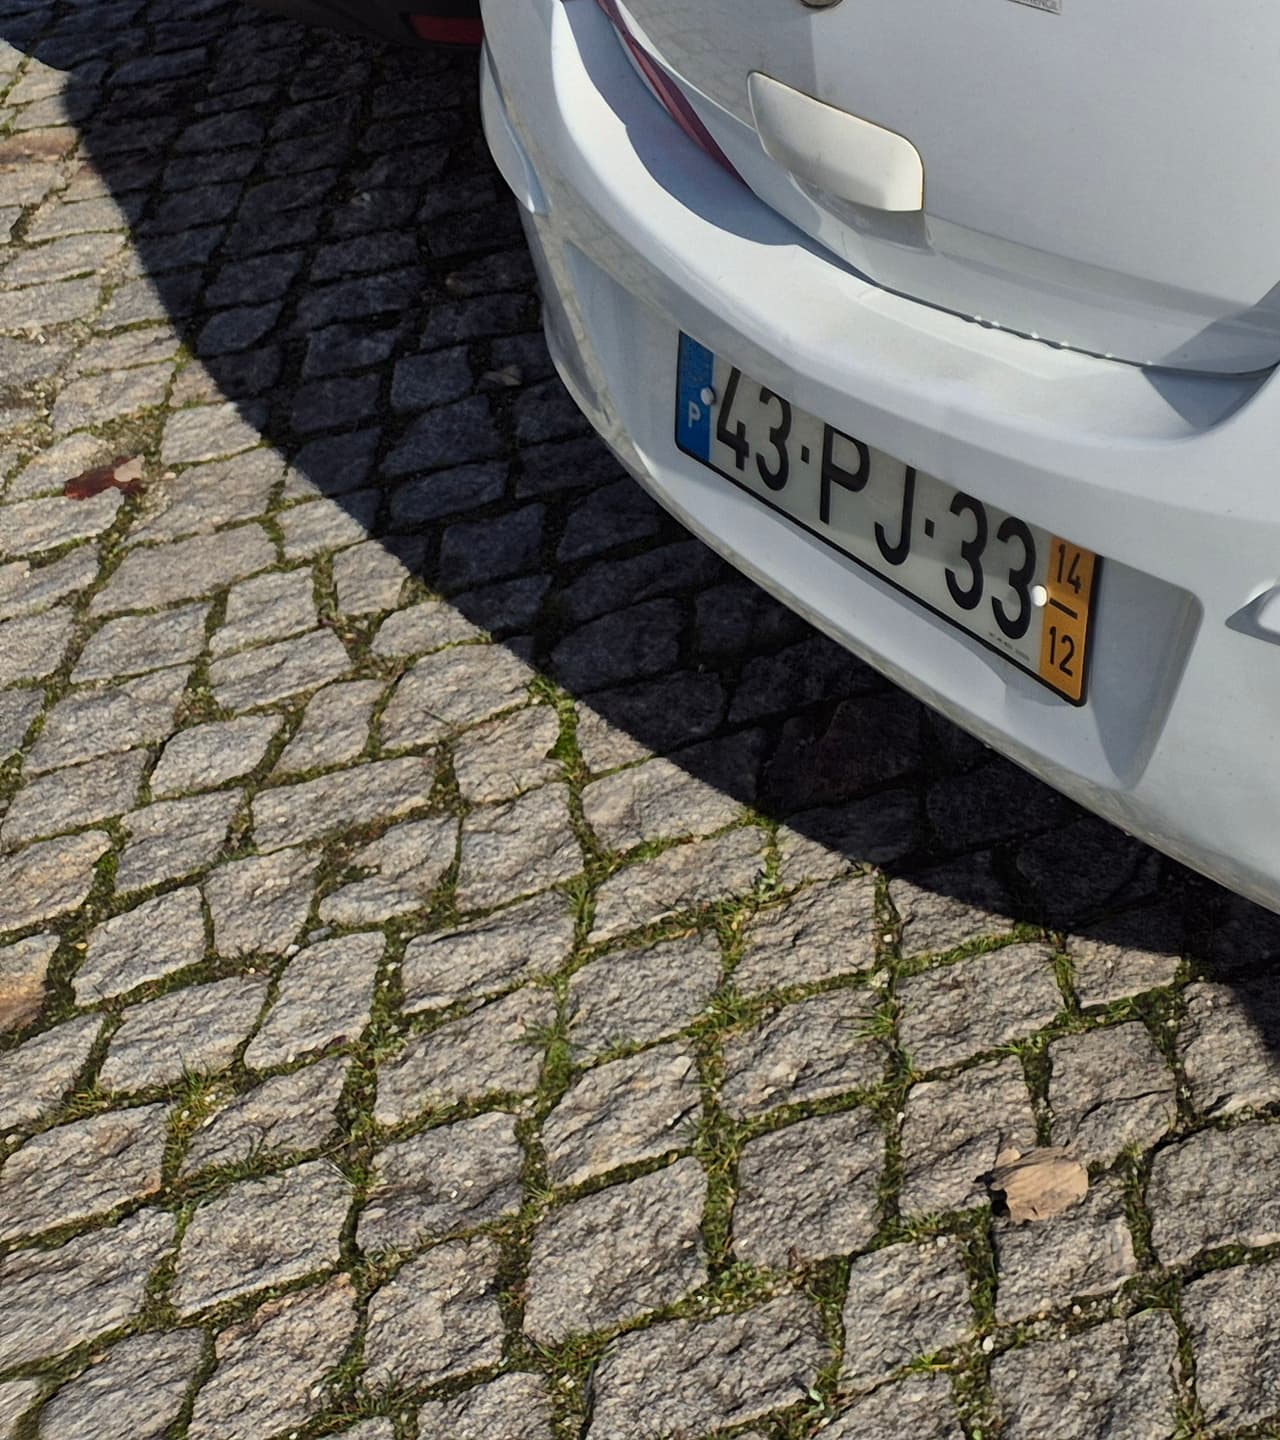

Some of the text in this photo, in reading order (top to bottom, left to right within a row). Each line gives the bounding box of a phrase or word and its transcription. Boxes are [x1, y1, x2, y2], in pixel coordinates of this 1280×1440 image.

[687, 401, 702, 429] P
[1056, 543, 1083, 595] 14
[1047, 626, 1076, 678] 12
